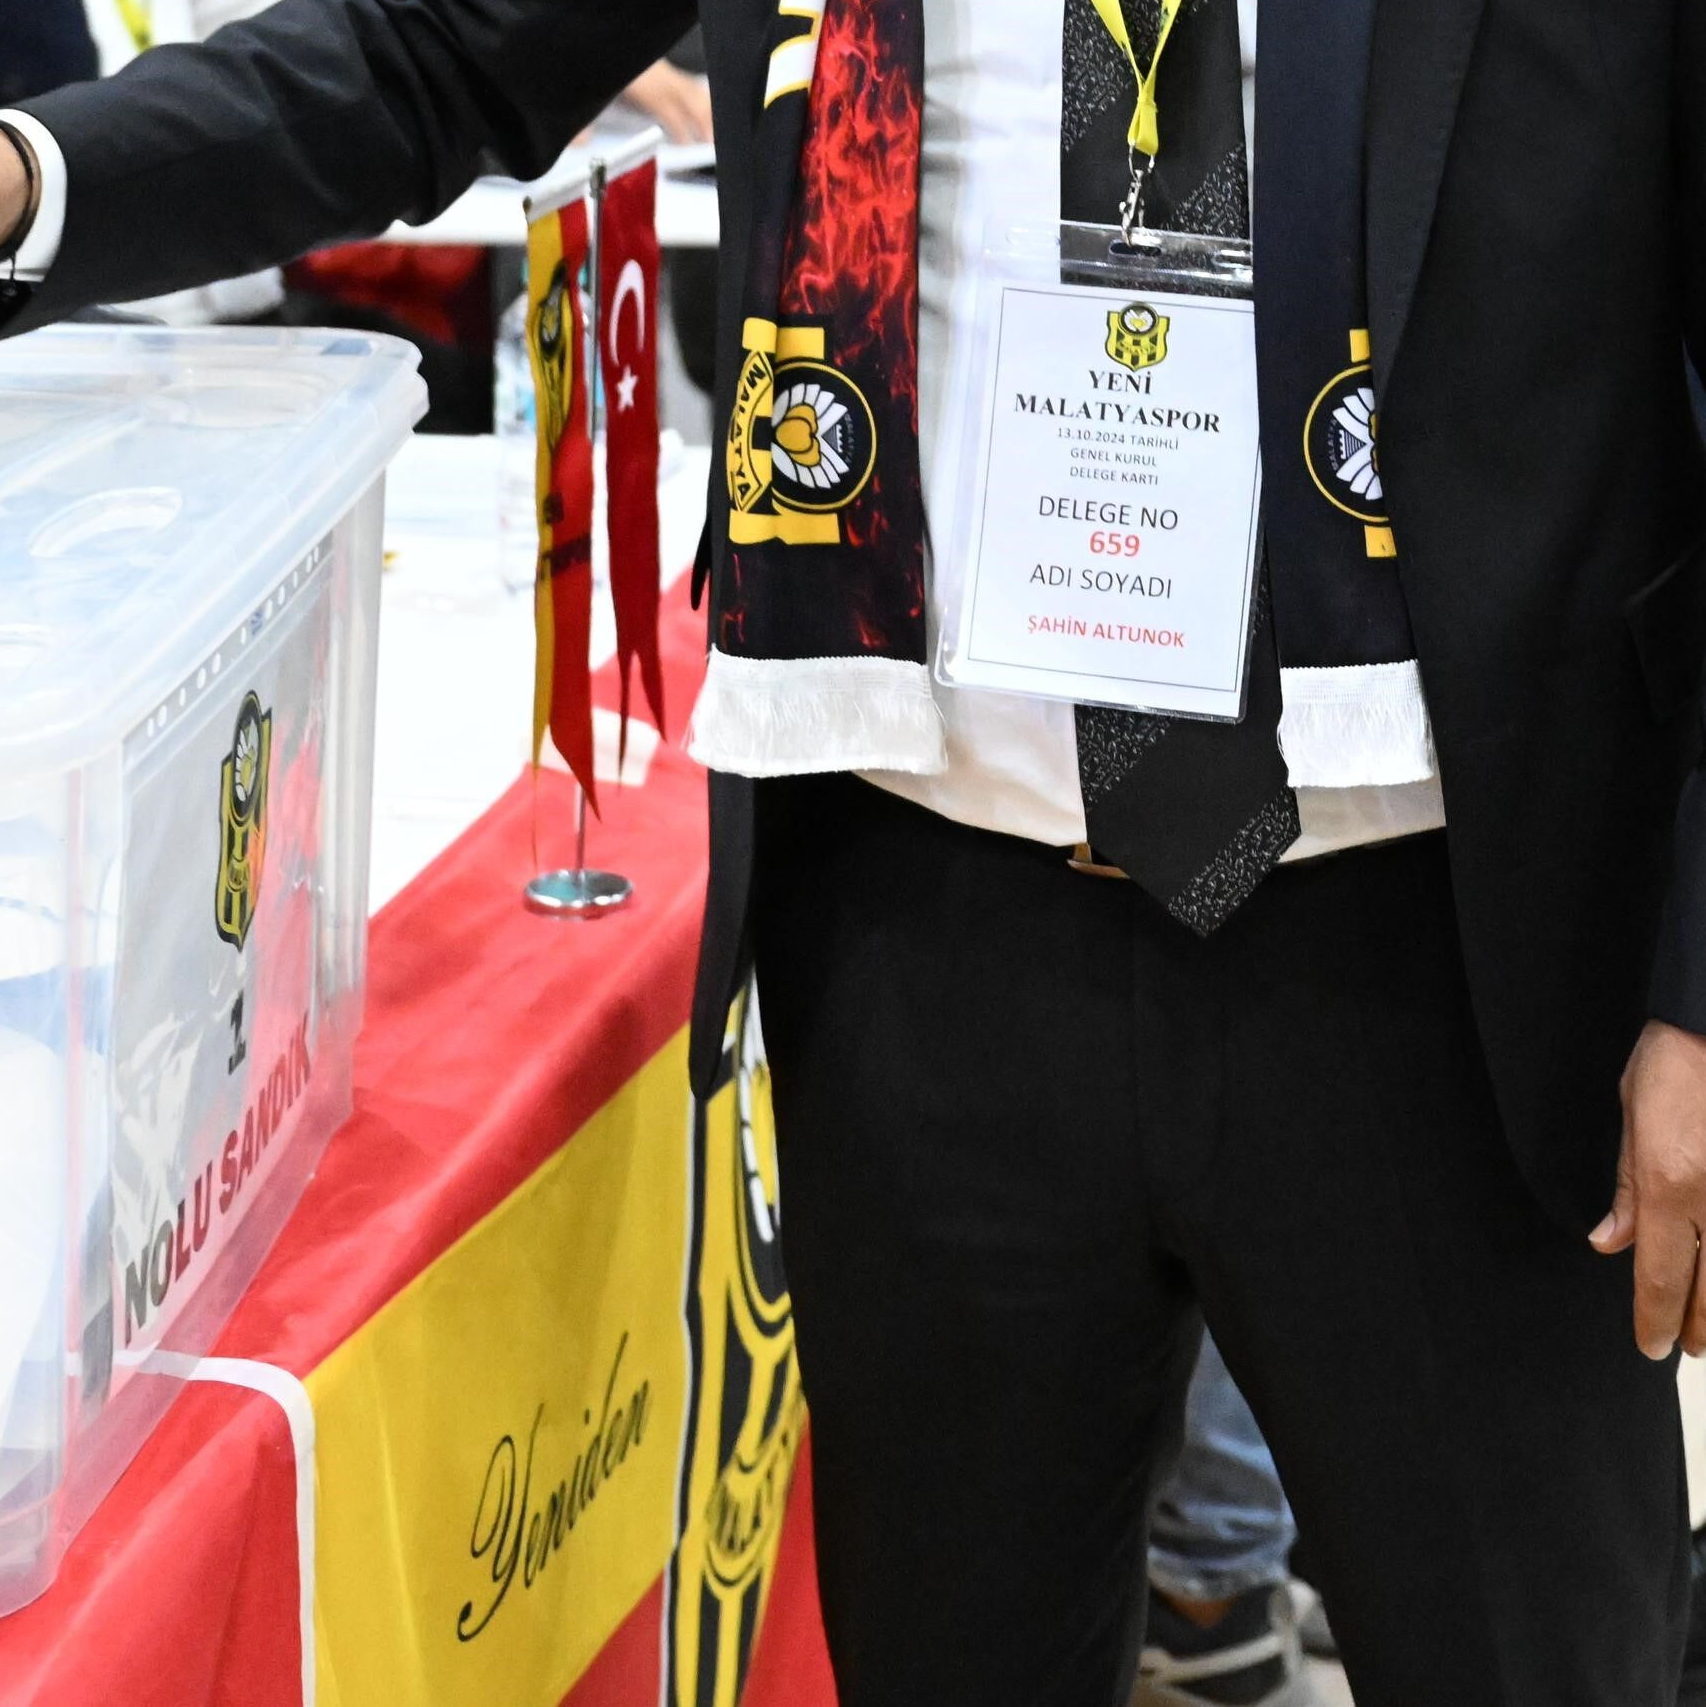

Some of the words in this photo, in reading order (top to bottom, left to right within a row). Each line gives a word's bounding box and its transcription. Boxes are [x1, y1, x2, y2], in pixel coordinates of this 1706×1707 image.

[1089, 370, 1152, 395] YENİ
[1015, 392, 1221, 433] MALATYASPOR
[1057, 427, 1126, 444] 13.10.2024
[1130, 433, 1179, 451] TARİHLİ
[1070, 447, 1111, 462] GENEL
[1115, 451, 1158, 467] KURUL
[1069, 466, 1118, 482] DELEGE
[1121, 471, 1160, 486] KARTI
[1038, 495, 1132, 526] DELEGE
[1139, 506, 1179, 531] NO
[1089, 530, 1141, 558] 659
[1029, 563, 1072, 588] ADI
[1080, 568, 1173, 599] SOYADI
[1027, 615, 1088, 637] ŞAHİN
[1092, 622, 1186, 648] ALTUNOK
[227, 989, 247, 1077] 1
[124, 1159, 214, 1351] NOLU
[218, 1010, 311, 1215] SANDIK
[457, 1330, 650, 1642] Yeniden
